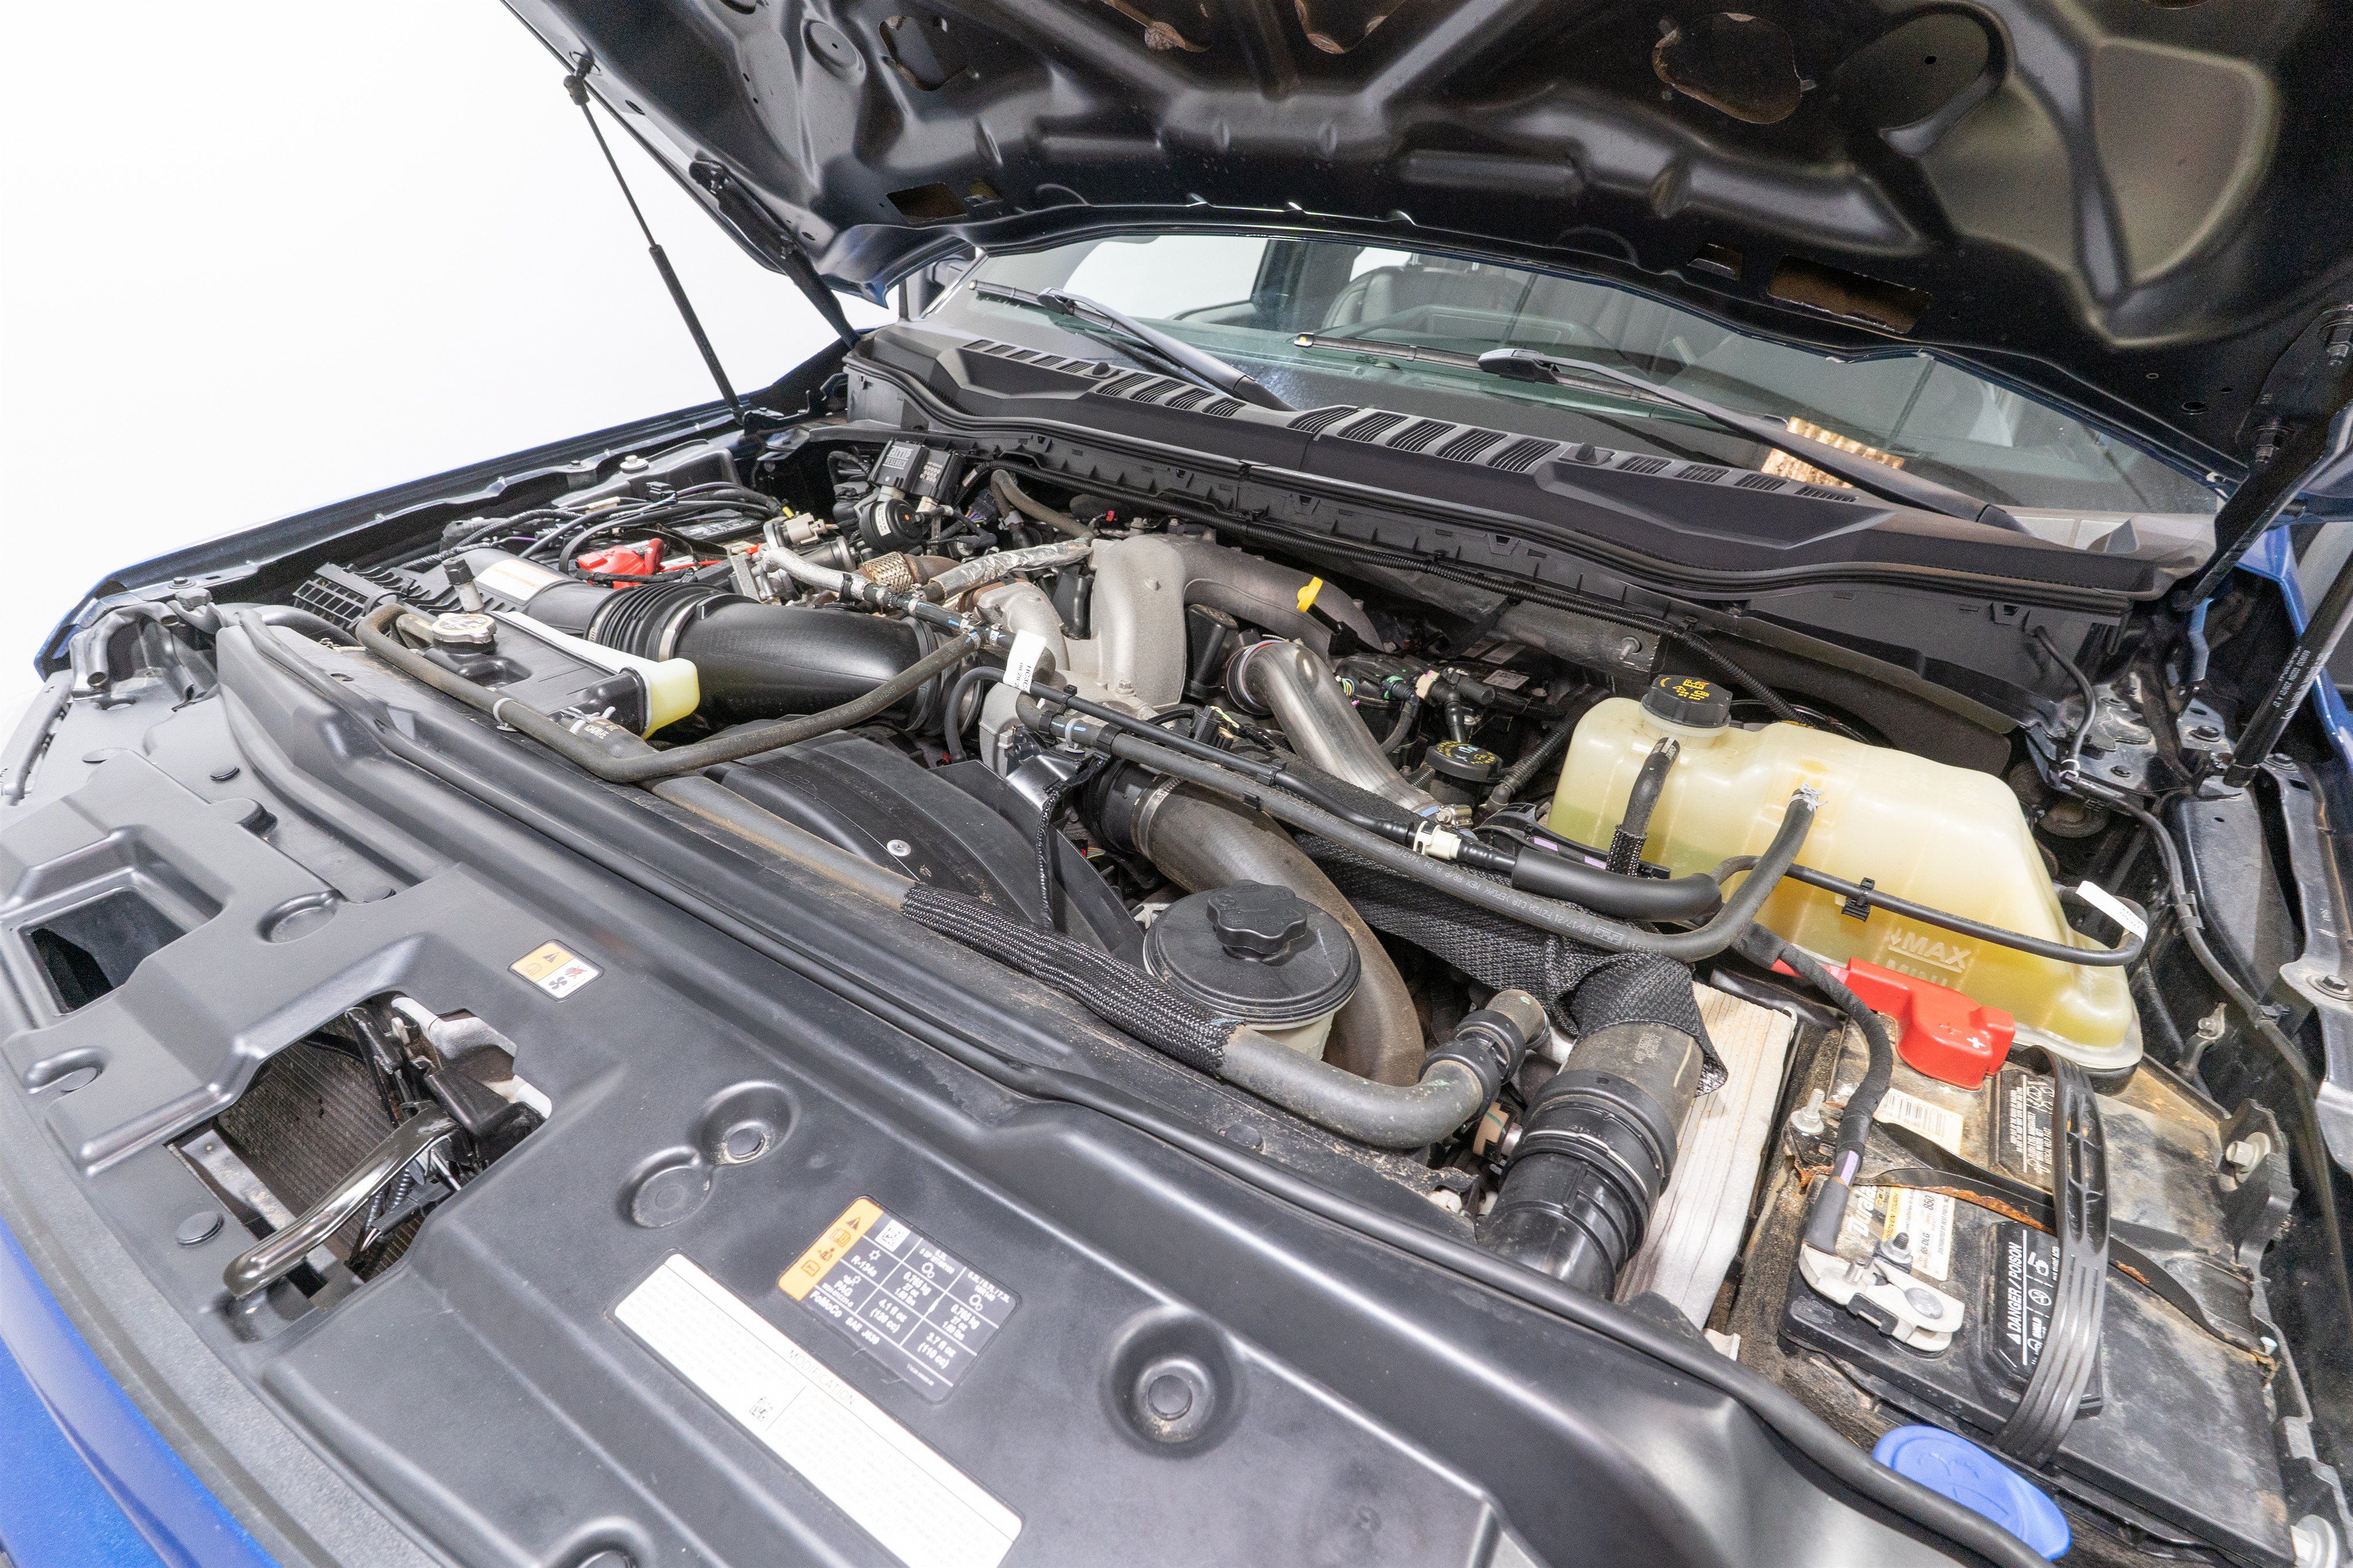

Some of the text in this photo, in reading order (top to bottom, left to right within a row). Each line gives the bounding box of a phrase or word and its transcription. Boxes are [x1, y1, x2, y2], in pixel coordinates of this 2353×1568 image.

[1387, 843, 1421, 863] 14:31:46
[1444, 868, 1464, 883] RR/P
[1465, 878, 1481, 890] MEX
[1511, 897, 1527, 909] CIP
[1553, 913, 1592, 935] 08/17/21
[1901, 930, 1972, 969] MAX
[2027, 1111, 2035, 1158] FLUSH EYES IMMEDIATELY
[2035, 1127, 2043, 1137] GET
[2035, 1150, 2043, 1161] WITH
[2043, 1126, 2051, 1165] MEDICAL HELP FAST
[1874, 1185, 1886, 1208] GOL
[1923, 1195, 1934, 1210] 850
[1847, 1185, 1877, 1237] Durala
[1886, 1192, 1899, 1239] PROVEN TOUGH
[1920, 1232, 1930, 1254] 65-DLG
[1938, 1230, 1946, 1254] DISTRIBUTED
[851, 1256, 877, 1276] R-134a
[2008, 1241, 2022, 1279] POISON
[834, 1281, 853, 1296] PAG
[904, 1272, 931, 1295] 0.765 kg
[810, 1291, 842, 1316] FoMoCo
[846, 1317, 862, 1331] SAE
[870, 1308, 900, 1333] (120 cc)
[879, 1299, 892, 1310] 4.1
[896, 1312, 907, 1322] oz
[951, 1304, 979, 1329] 0.765 kg
[2007, 1287, 2022, 1333] DANGER
[2032, 1316, 2042, 1338] SHIELD
[917, 1343, 949, 1369] (110 cc)
[926, 1333, 940, 1344] 3.7
[944, 1347, 956, 1357] oz
[786, 1348, 857, 1406] MODIFICATION
